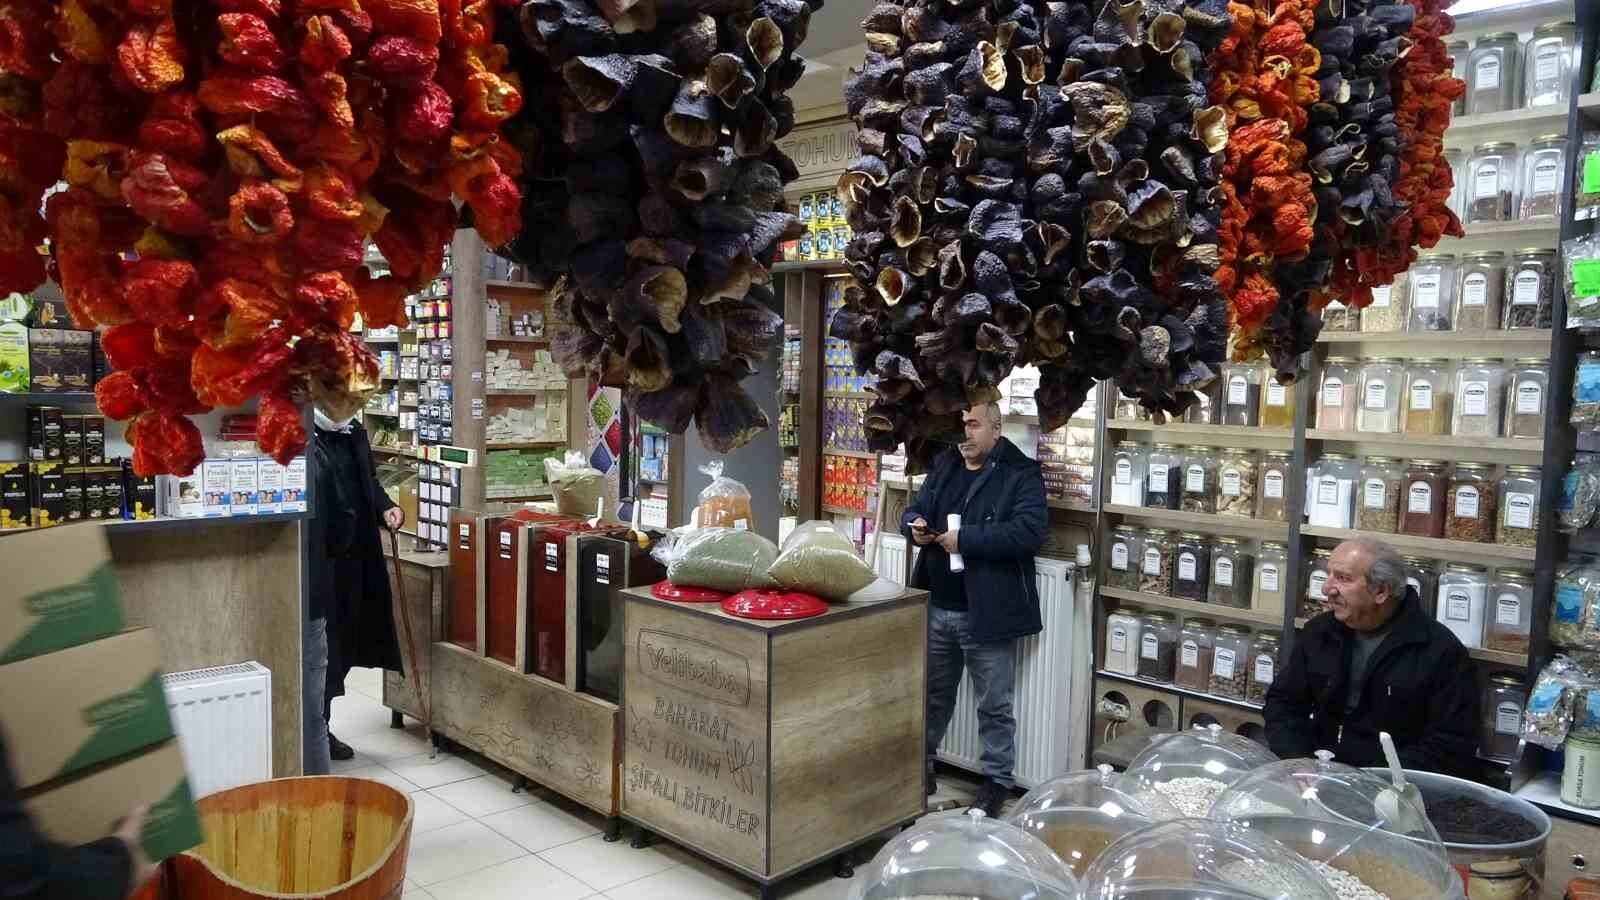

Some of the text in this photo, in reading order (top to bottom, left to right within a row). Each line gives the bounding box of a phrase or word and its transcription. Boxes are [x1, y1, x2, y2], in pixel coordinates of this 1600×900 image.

[647, 643, 741, 696] Velibaba
[654, 697, 734, 742] BAHARAT
[664, 740, 721, 780] TOHUM
[629, 762, 760, 840] ŞİFALI BİTKİLER
